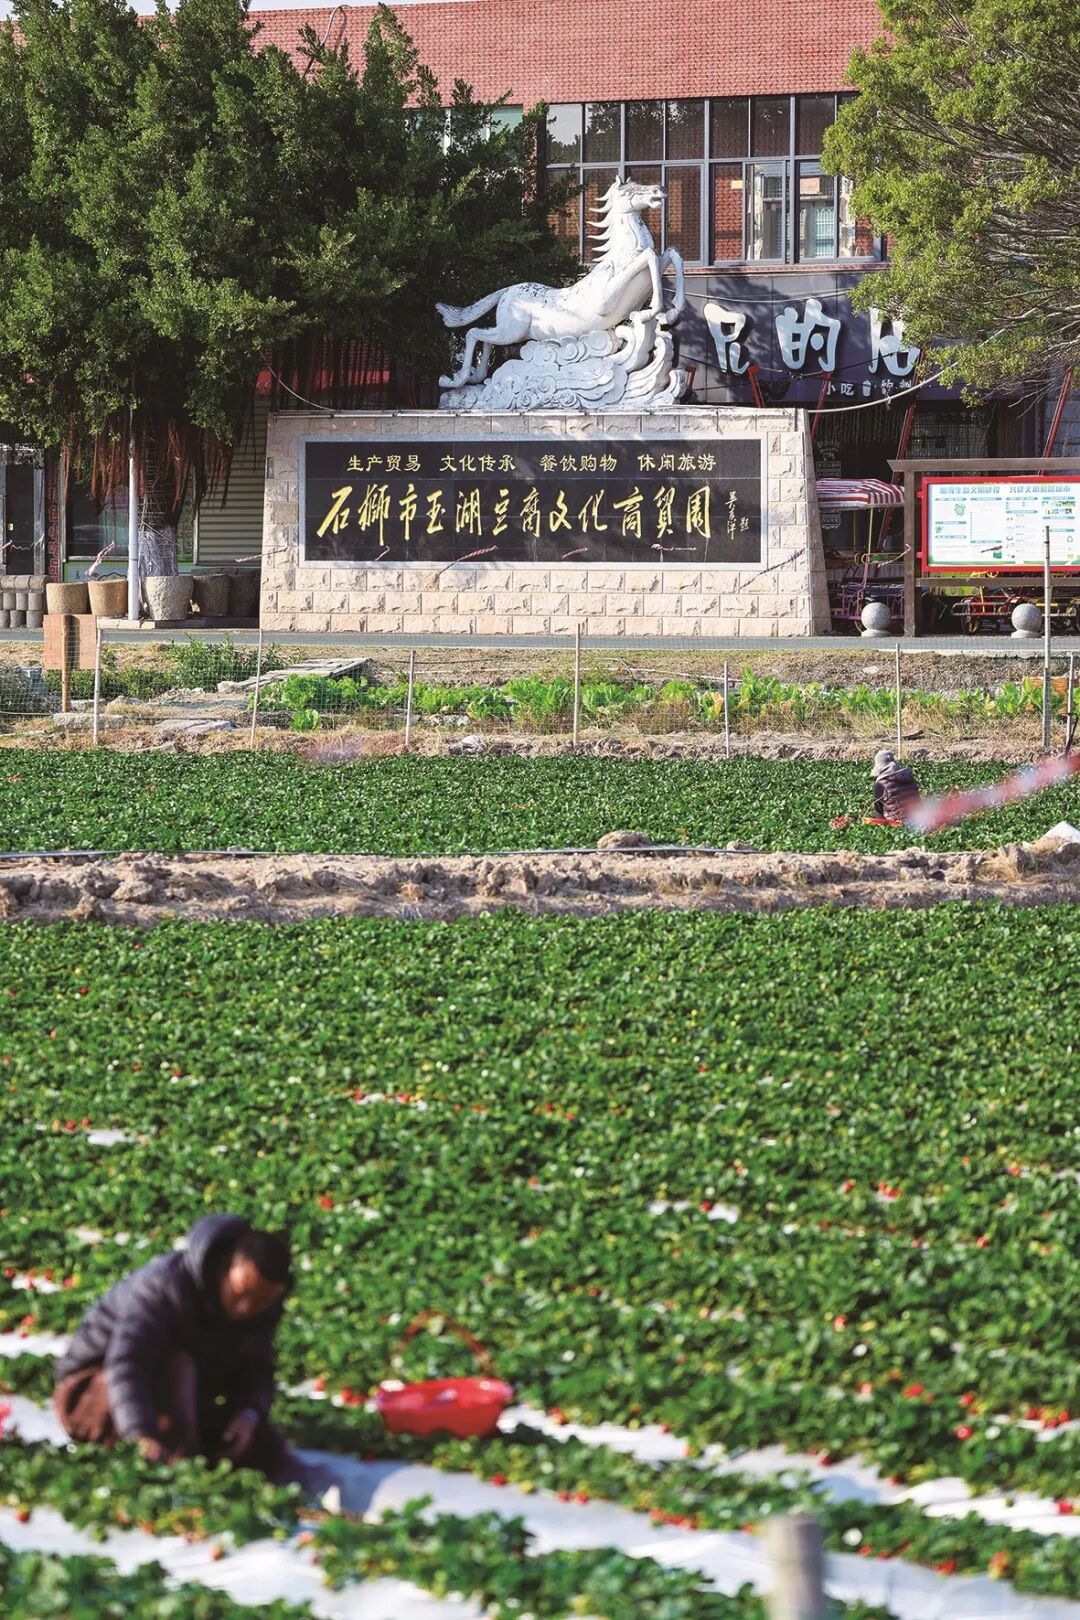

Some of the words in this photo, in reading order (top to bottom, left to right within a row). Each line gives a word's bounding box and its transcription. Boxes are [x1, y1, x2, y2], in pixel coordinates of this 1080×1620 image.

[347, 454, 421, 472] 生产贸易
[440, 454, 516, 472] 文化传承
[539, 453, 617, 472] 餐饮购物
[637, 453, 716, 472] 休闲旅游
